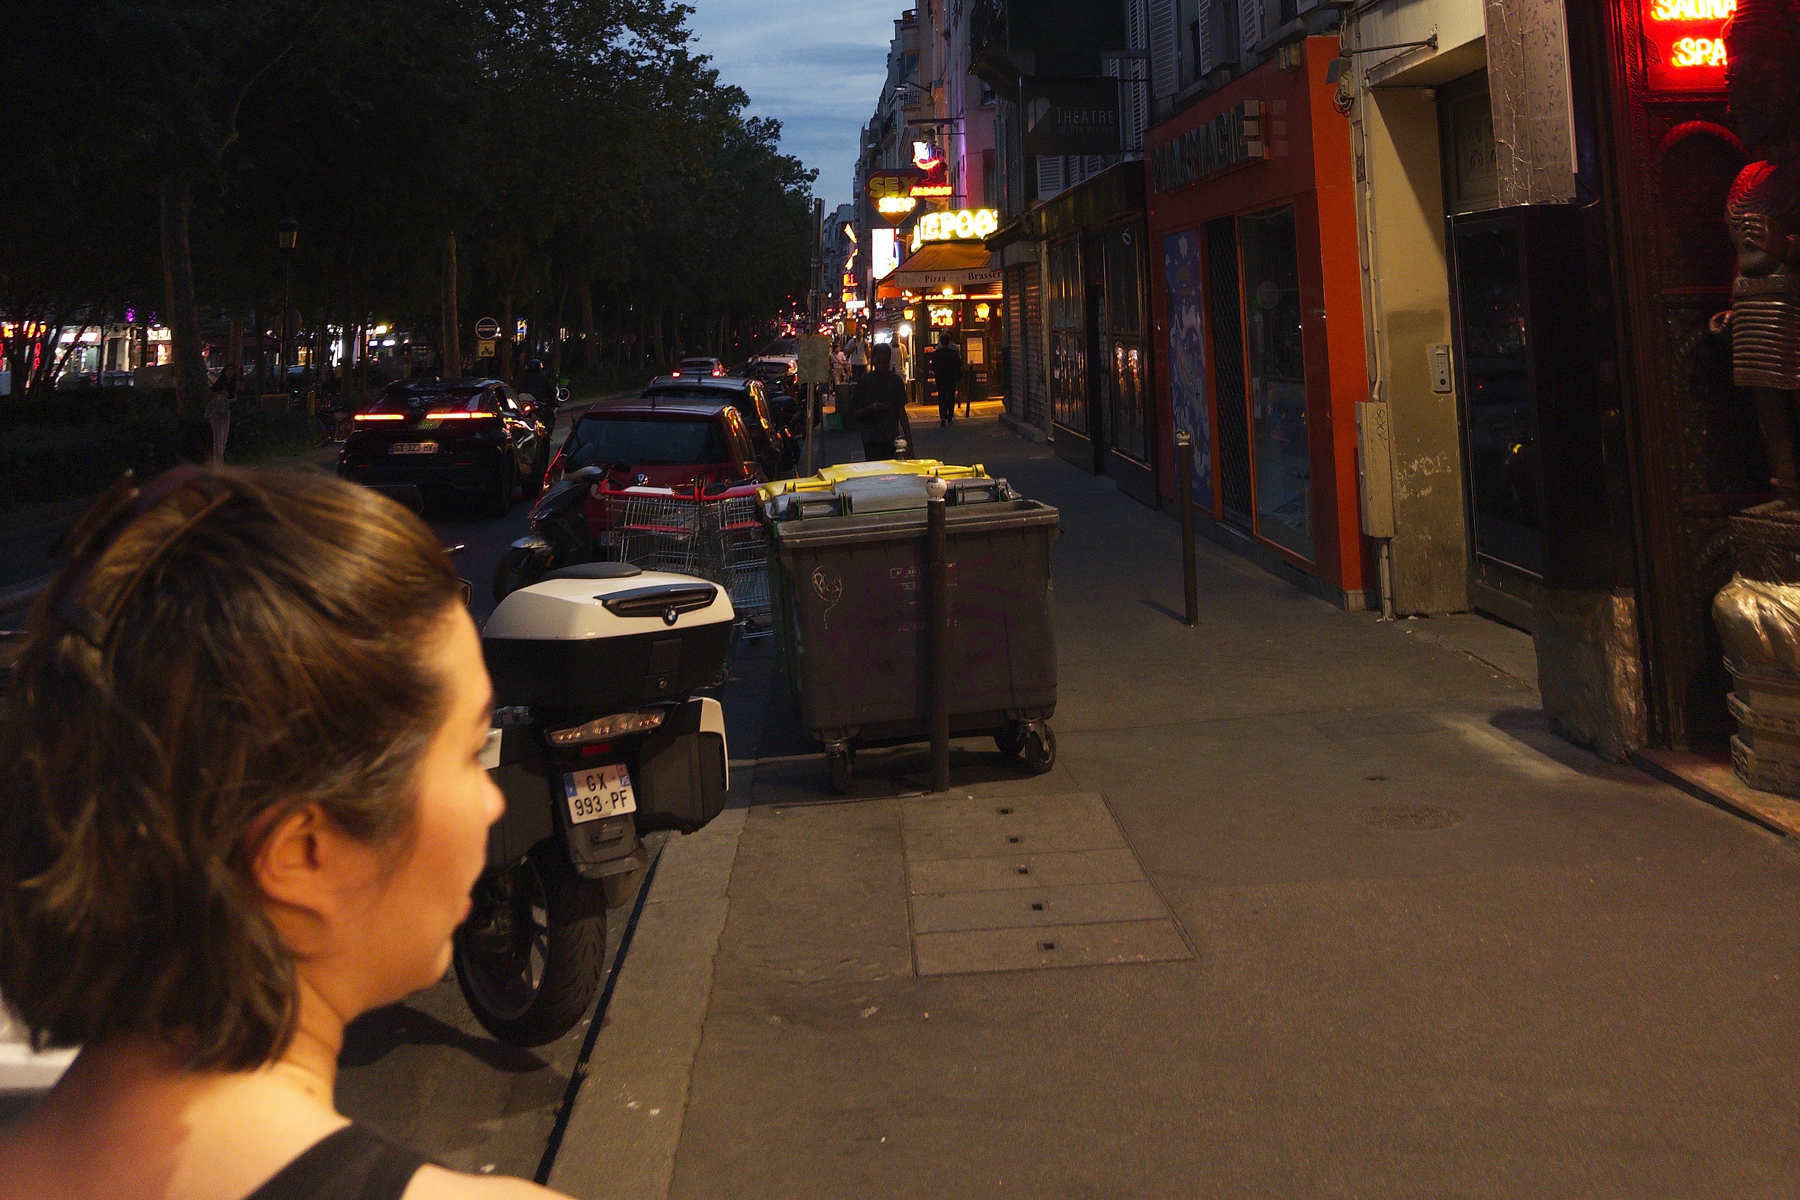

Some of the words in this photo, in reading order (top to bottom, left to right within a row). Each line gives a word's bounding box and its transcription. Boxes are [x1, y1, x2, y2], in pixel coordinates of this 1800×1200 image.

[1672, 38, 1727, 68] SPA
[1151, 100, 1264, 193] PHARMACIE
[869, 176, 919, 199] SEX
[878, 196, 916, 212] SHOP
[924, 274, 946, 283] Pizza
[968, 271, 1001, 281] Brasser
[931, 317, 953, 326] PUB
[574, 790, 627, 817] 993-PF
